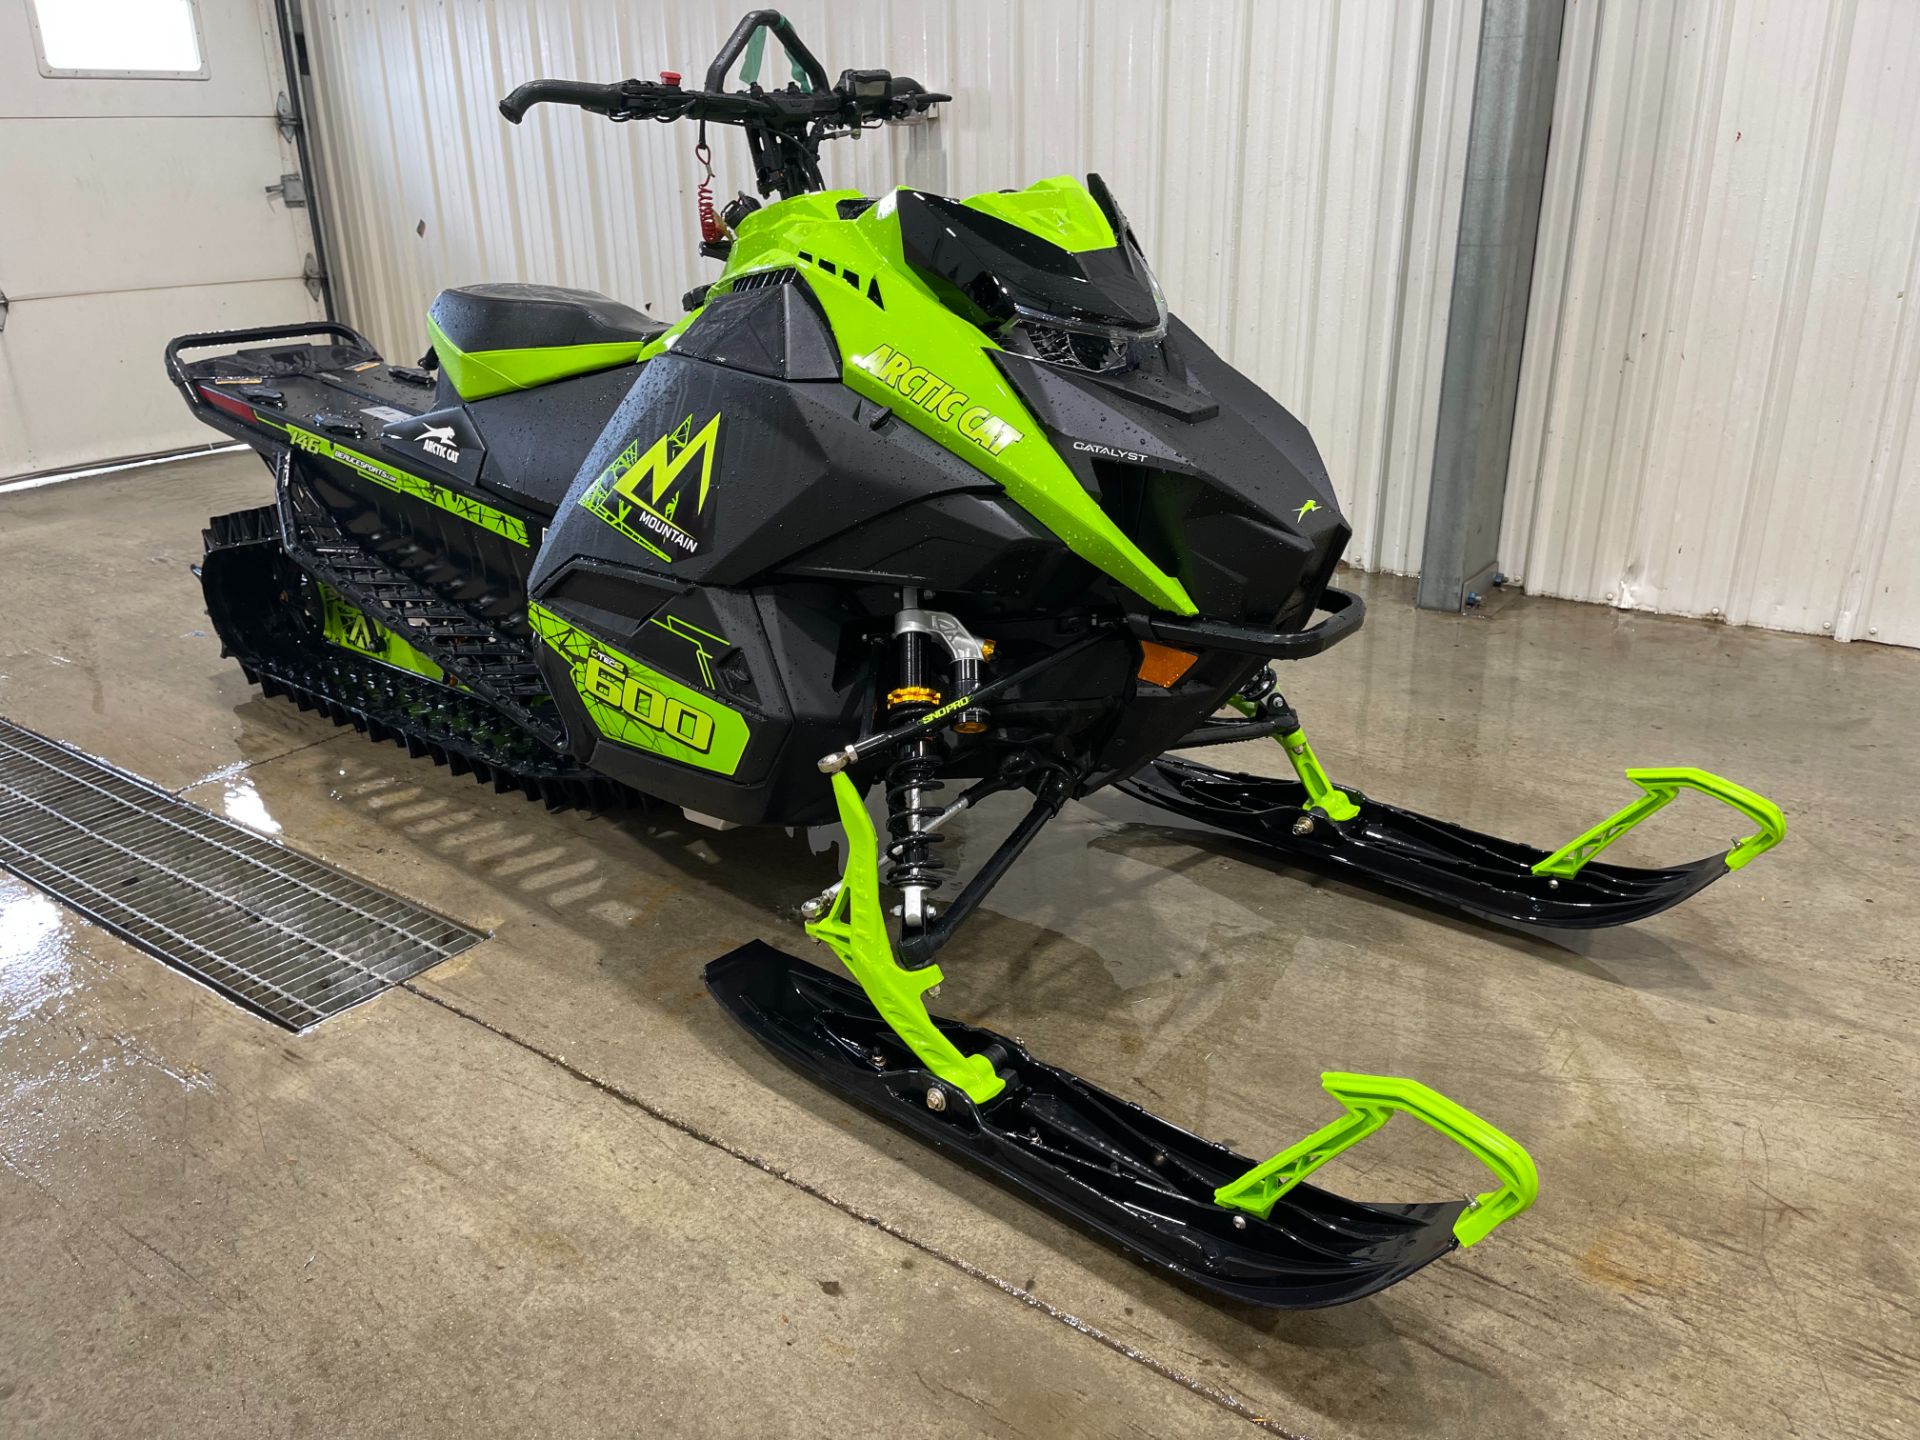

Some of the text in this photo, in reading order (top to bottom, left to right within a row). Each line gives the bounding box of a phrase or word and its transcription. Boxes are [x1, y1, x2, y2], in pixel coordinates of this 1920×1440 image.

[855, 343, 1025, 456] ARCTIC CAT
[289, 431, 320, 454] 146
[423, 439, 460, 463] ARCTIC CAT
[1073, 441, 1149, 462] CATALYST
[638, 511, 698, 553] MOUNTAIN
[584, 656, 715, 755] 600
[946, 696, 970, 714] PRO
